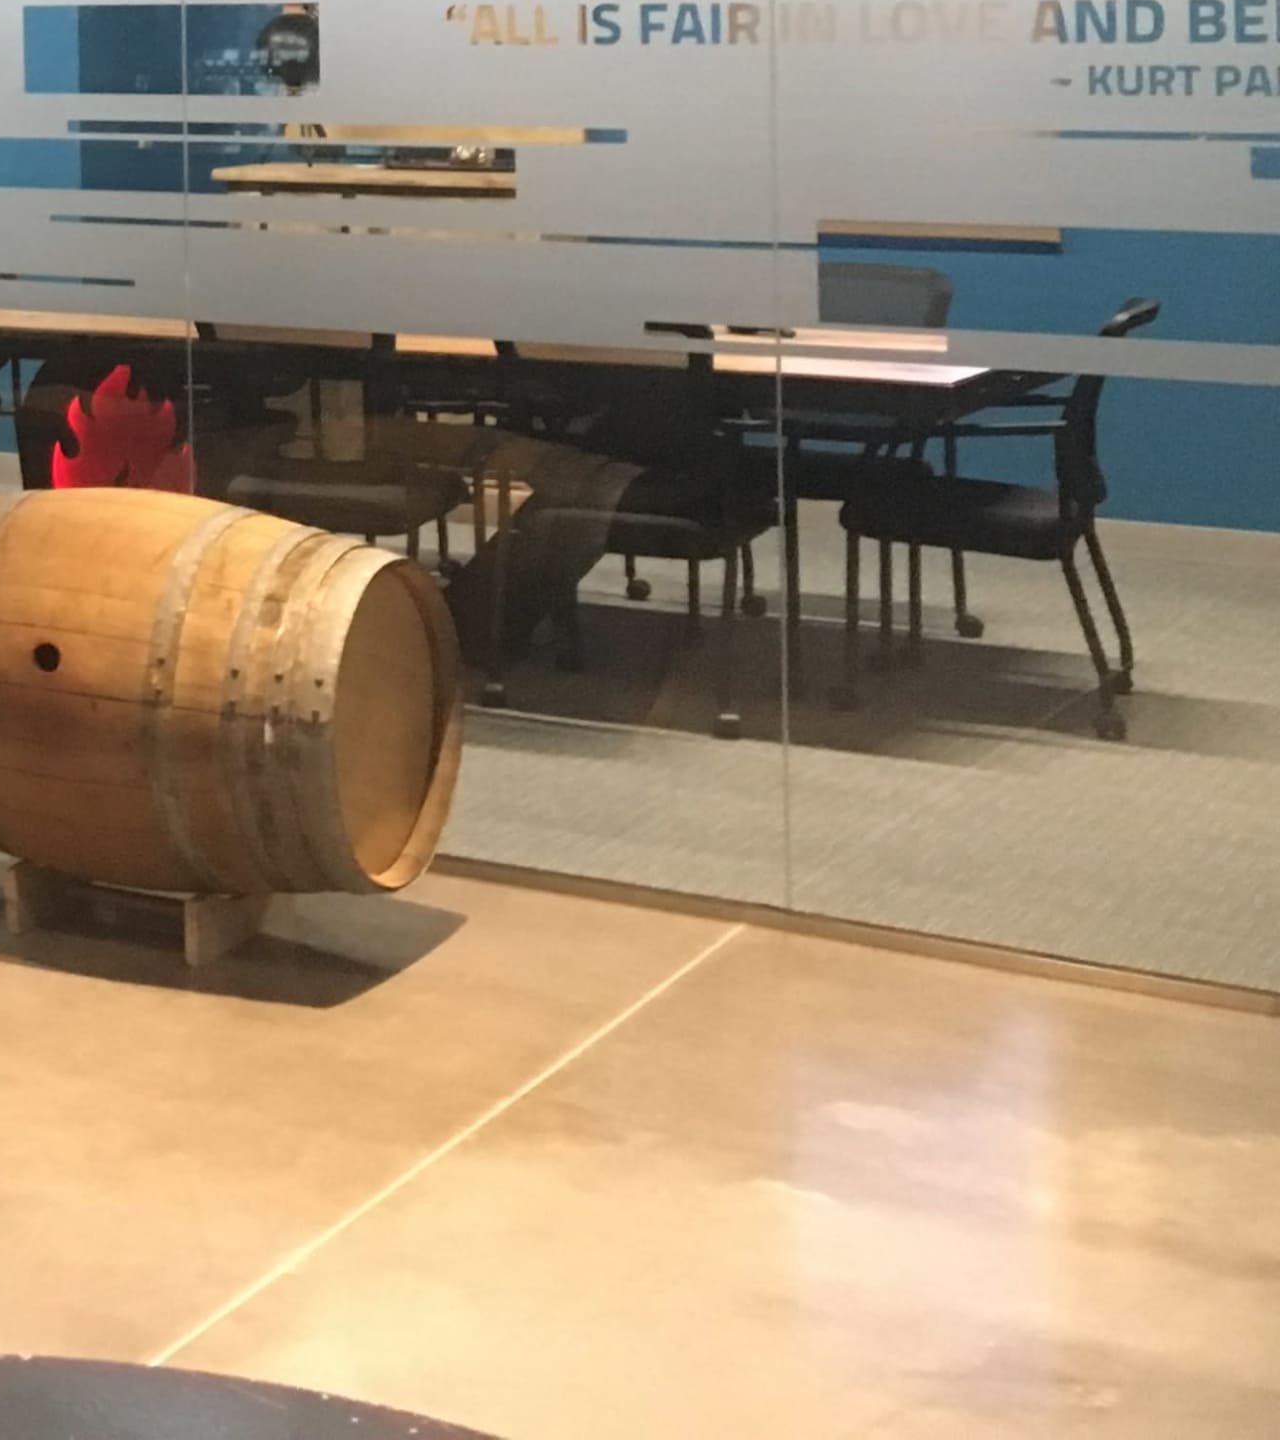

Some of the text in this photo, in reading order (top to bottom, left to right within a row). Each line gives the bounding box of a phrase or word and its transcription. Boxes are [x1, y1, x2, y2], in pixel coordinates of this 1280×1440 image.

[446, 3, 560, 46] “ALL
[578, 3, 621, 46] IS
[639, 2, 761, 46] FAIR
[779, 1, 837, 44] IN
[859, 0, 1009, 43] LOVE
[1088, 64, 1202, 97] KURT
[1215, 64, 1280, 97] PA
